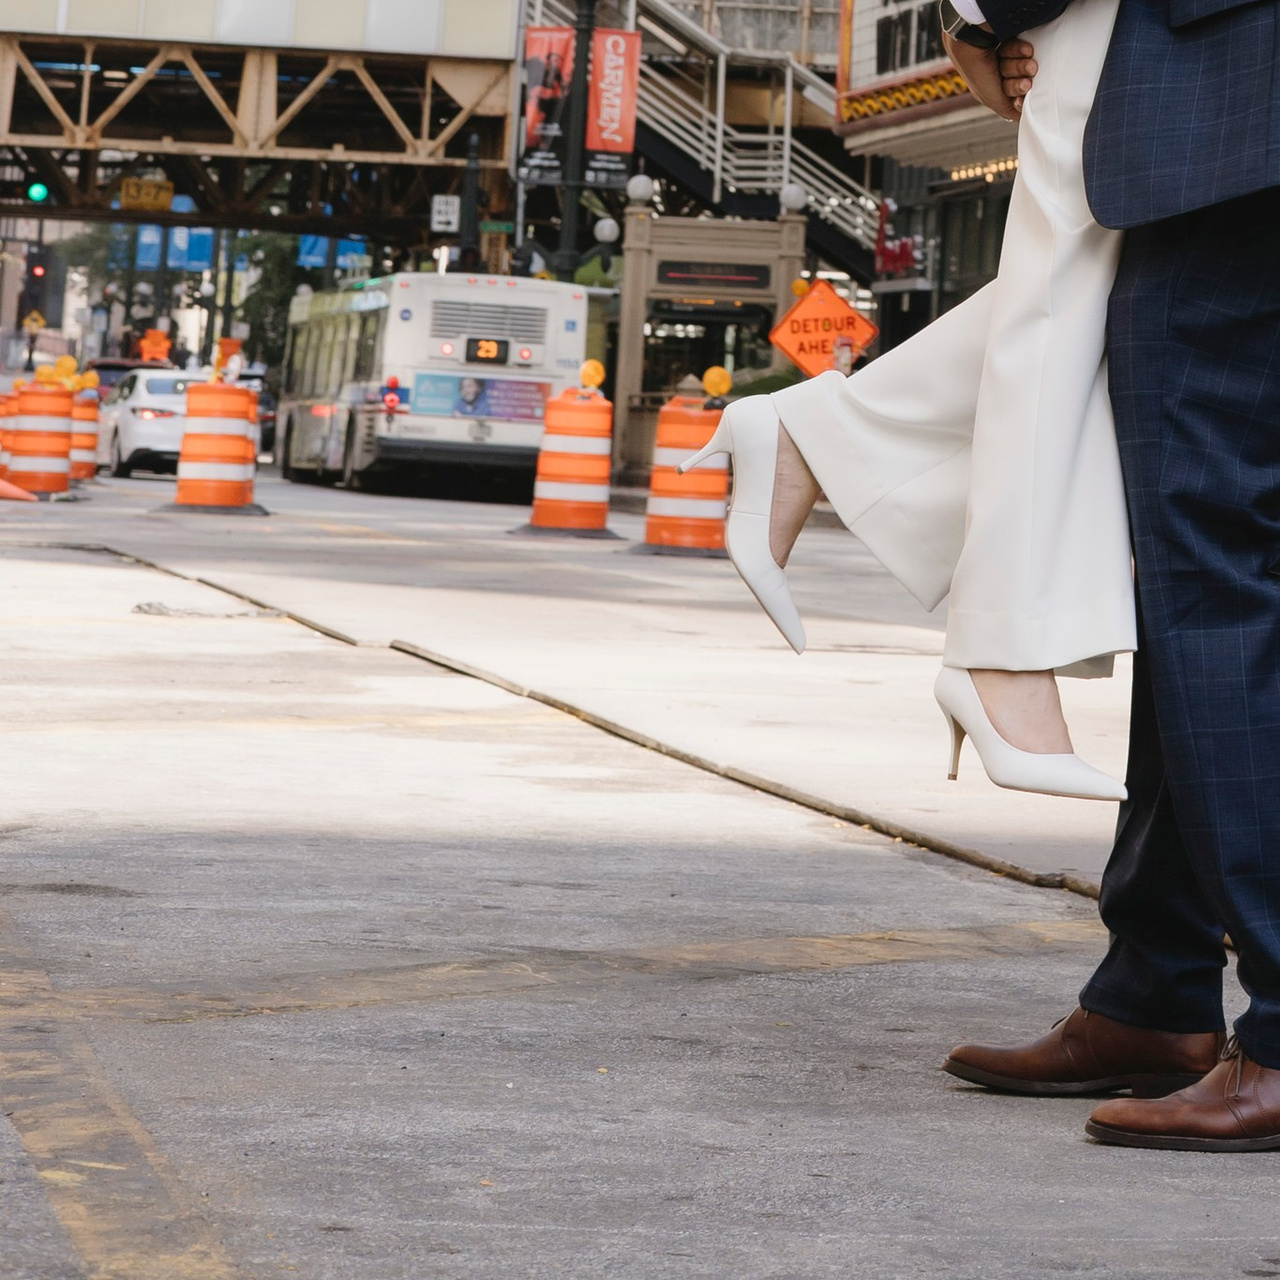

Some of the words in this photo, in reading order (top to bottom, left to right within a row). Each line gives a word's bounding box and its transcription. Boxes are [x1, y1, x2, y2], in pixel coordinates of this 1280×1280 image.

[597, 34, 626, 143] CARMEN
[790, 316, 856, 334] DETOUR
[797, 340, 832, 355] AHE
